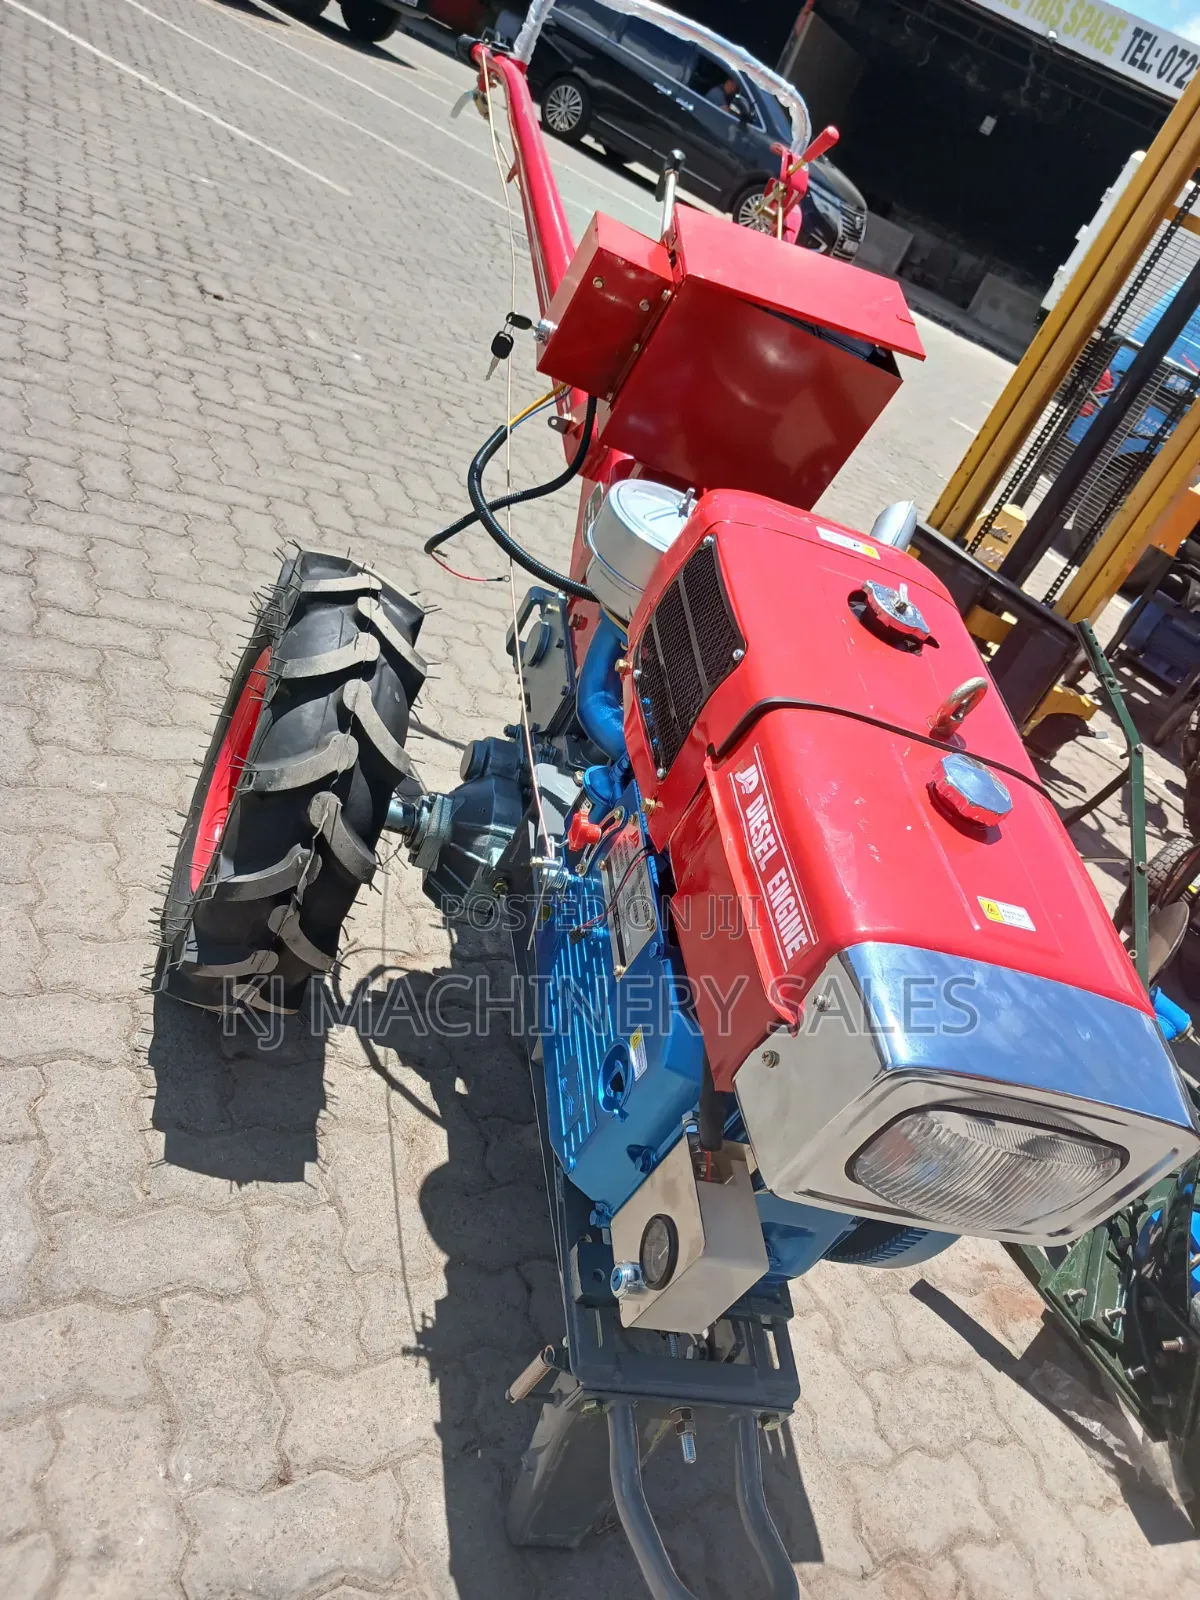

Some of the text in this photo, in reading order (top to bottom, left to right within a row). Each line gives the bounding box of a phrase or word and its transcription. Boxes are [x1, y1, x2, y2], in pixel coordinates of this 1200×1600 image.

[1063, 0, 1128, 56] SPACE
[1121, 26, 1162, 74] TEL:
[1156, 44, 1200, 91] 072
[746, 793, 778, 872] DIESEL
[766, 866, 808, 960] ENGINE
